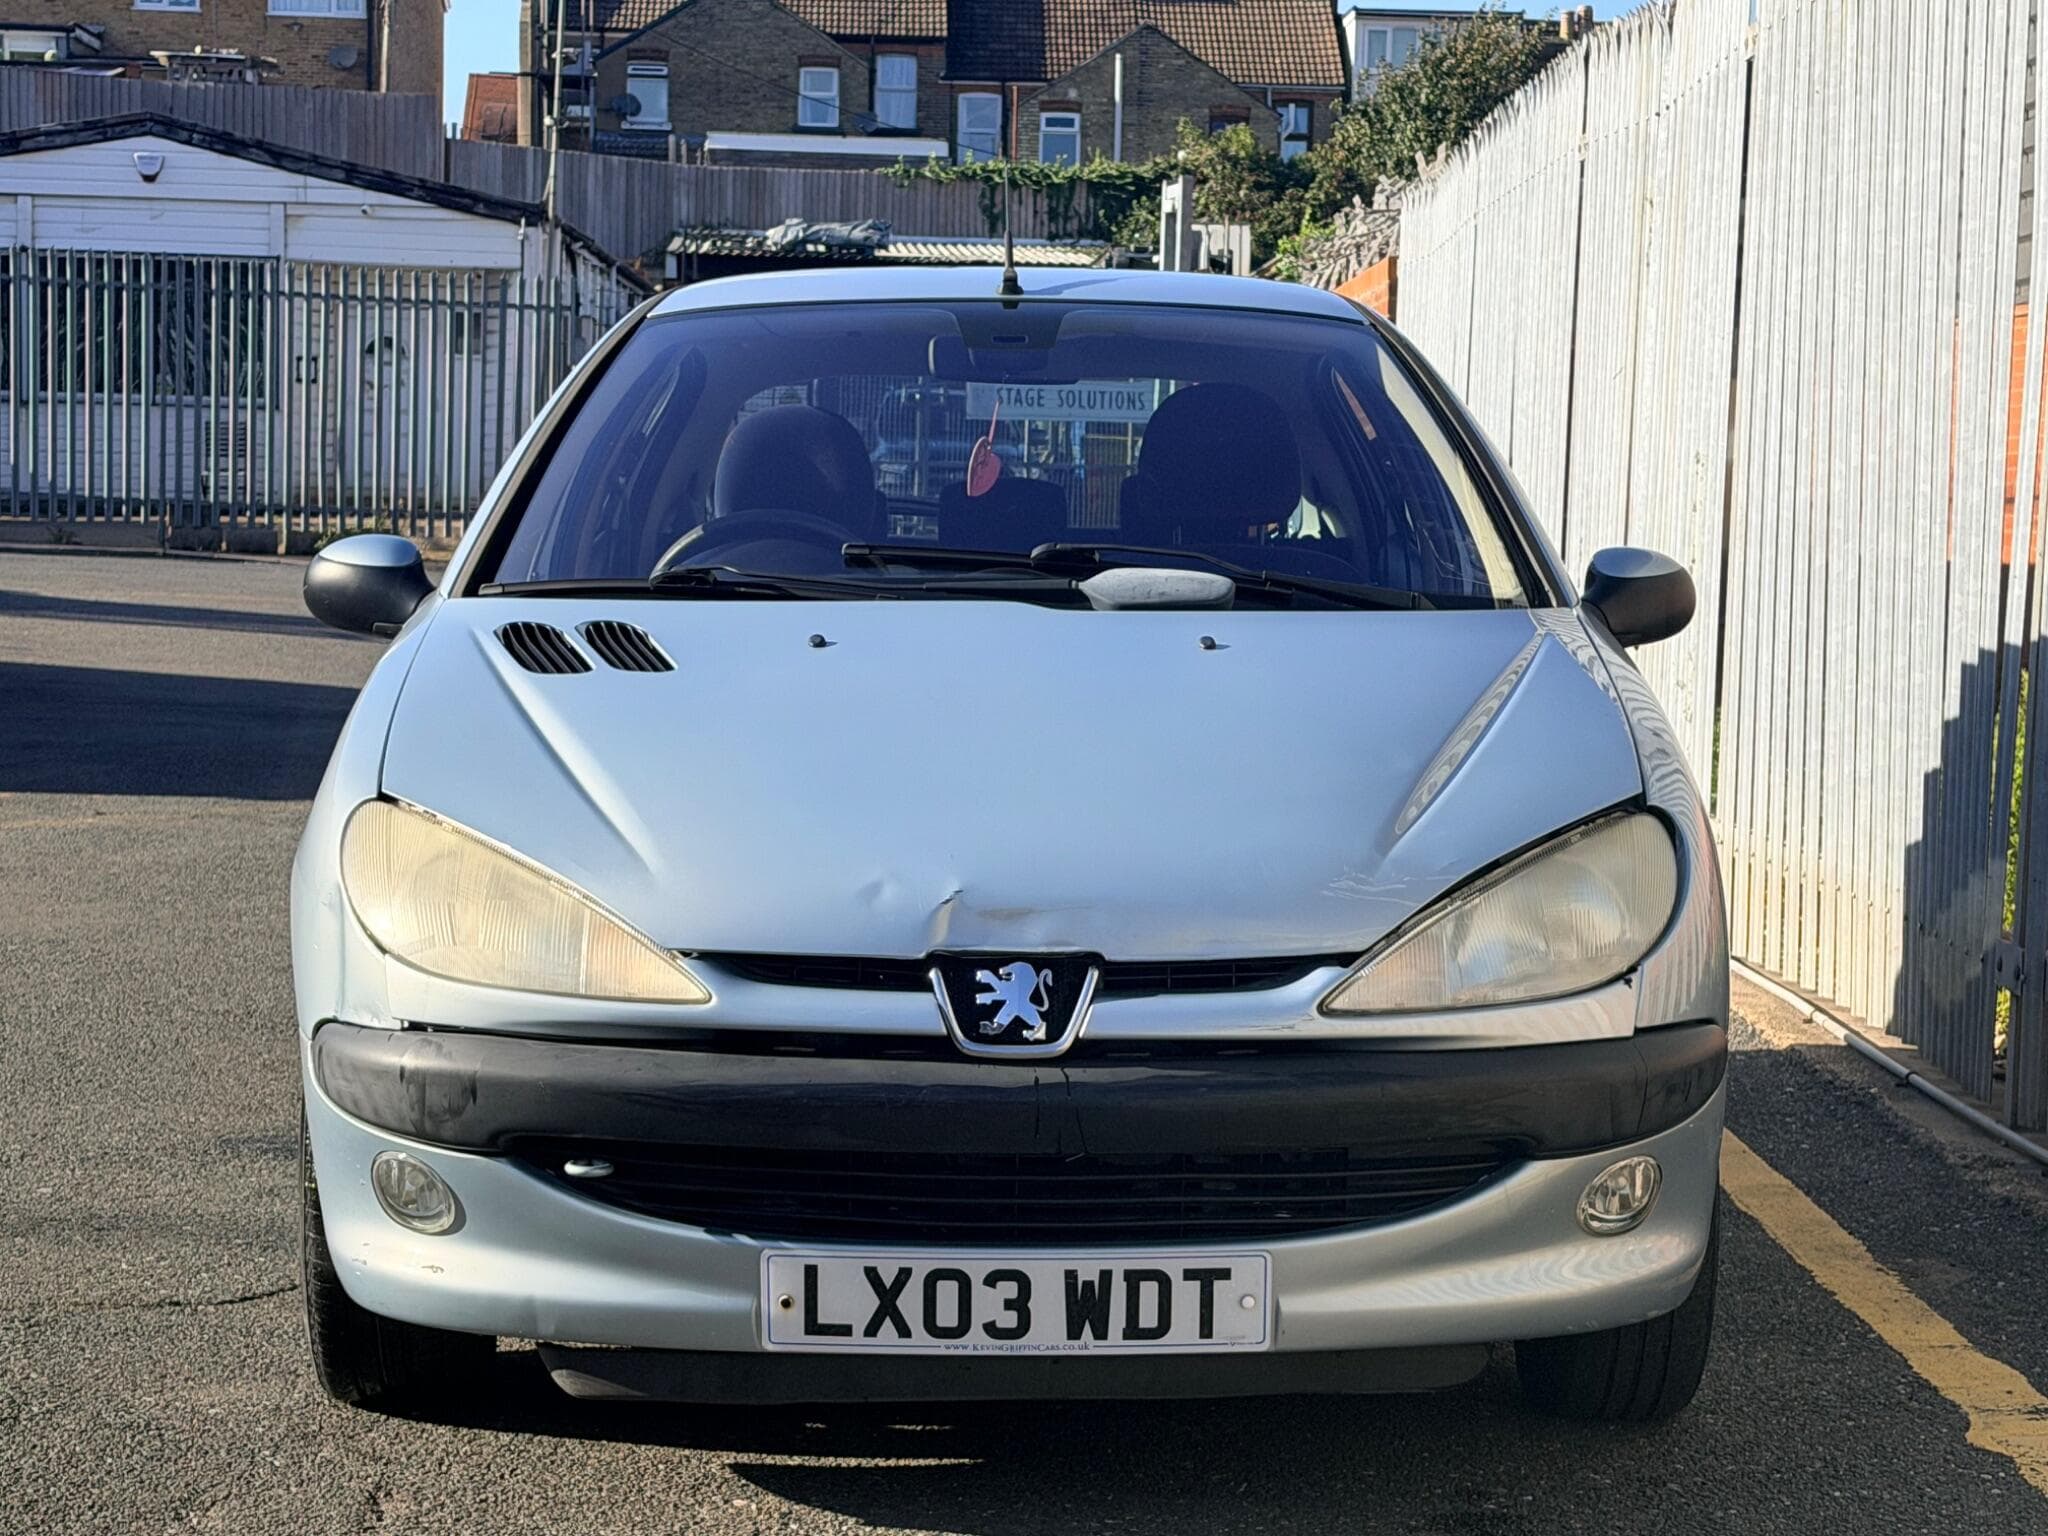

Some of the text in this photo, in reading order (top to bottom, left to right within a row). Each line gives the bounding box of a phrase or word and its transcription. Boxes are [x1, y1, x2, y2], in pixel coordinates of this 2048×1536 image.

[996, 386, 1146, 410] STAGE SOLUTIONS
[803, 1264, 1232, 1341] LX03 WDT
